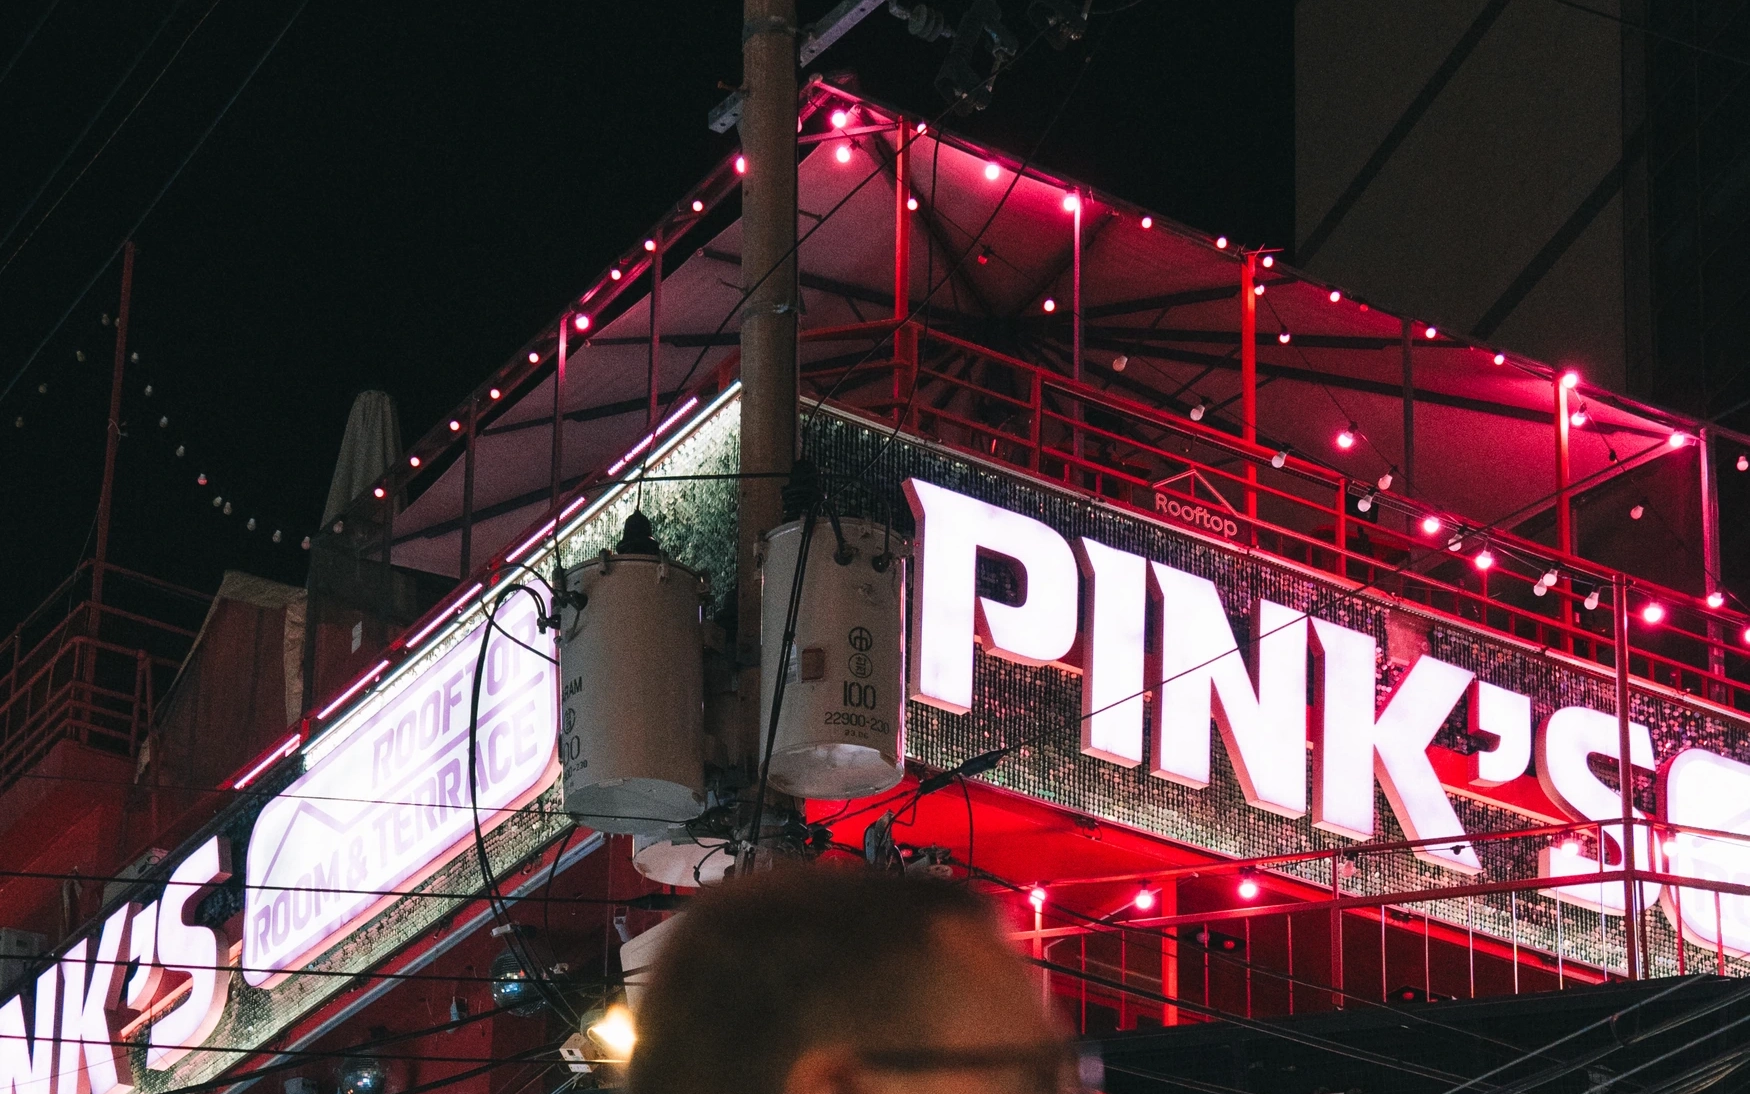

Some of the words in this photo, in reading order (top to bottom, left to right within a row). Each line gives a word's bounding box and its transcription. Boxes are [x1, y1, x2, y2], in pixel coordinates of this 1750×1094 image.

[1155, 492, 1238, 538] Rooftop
[843, 681, 877, 711] 100
[903, 476, 1663, 916] PINK'S
[824, 711, 890, 735] 22900-230
[252, 850, 341, 965] ROOM
[346, 833, 369, 890] &
[372, 699, 538, 867] TERRACE
